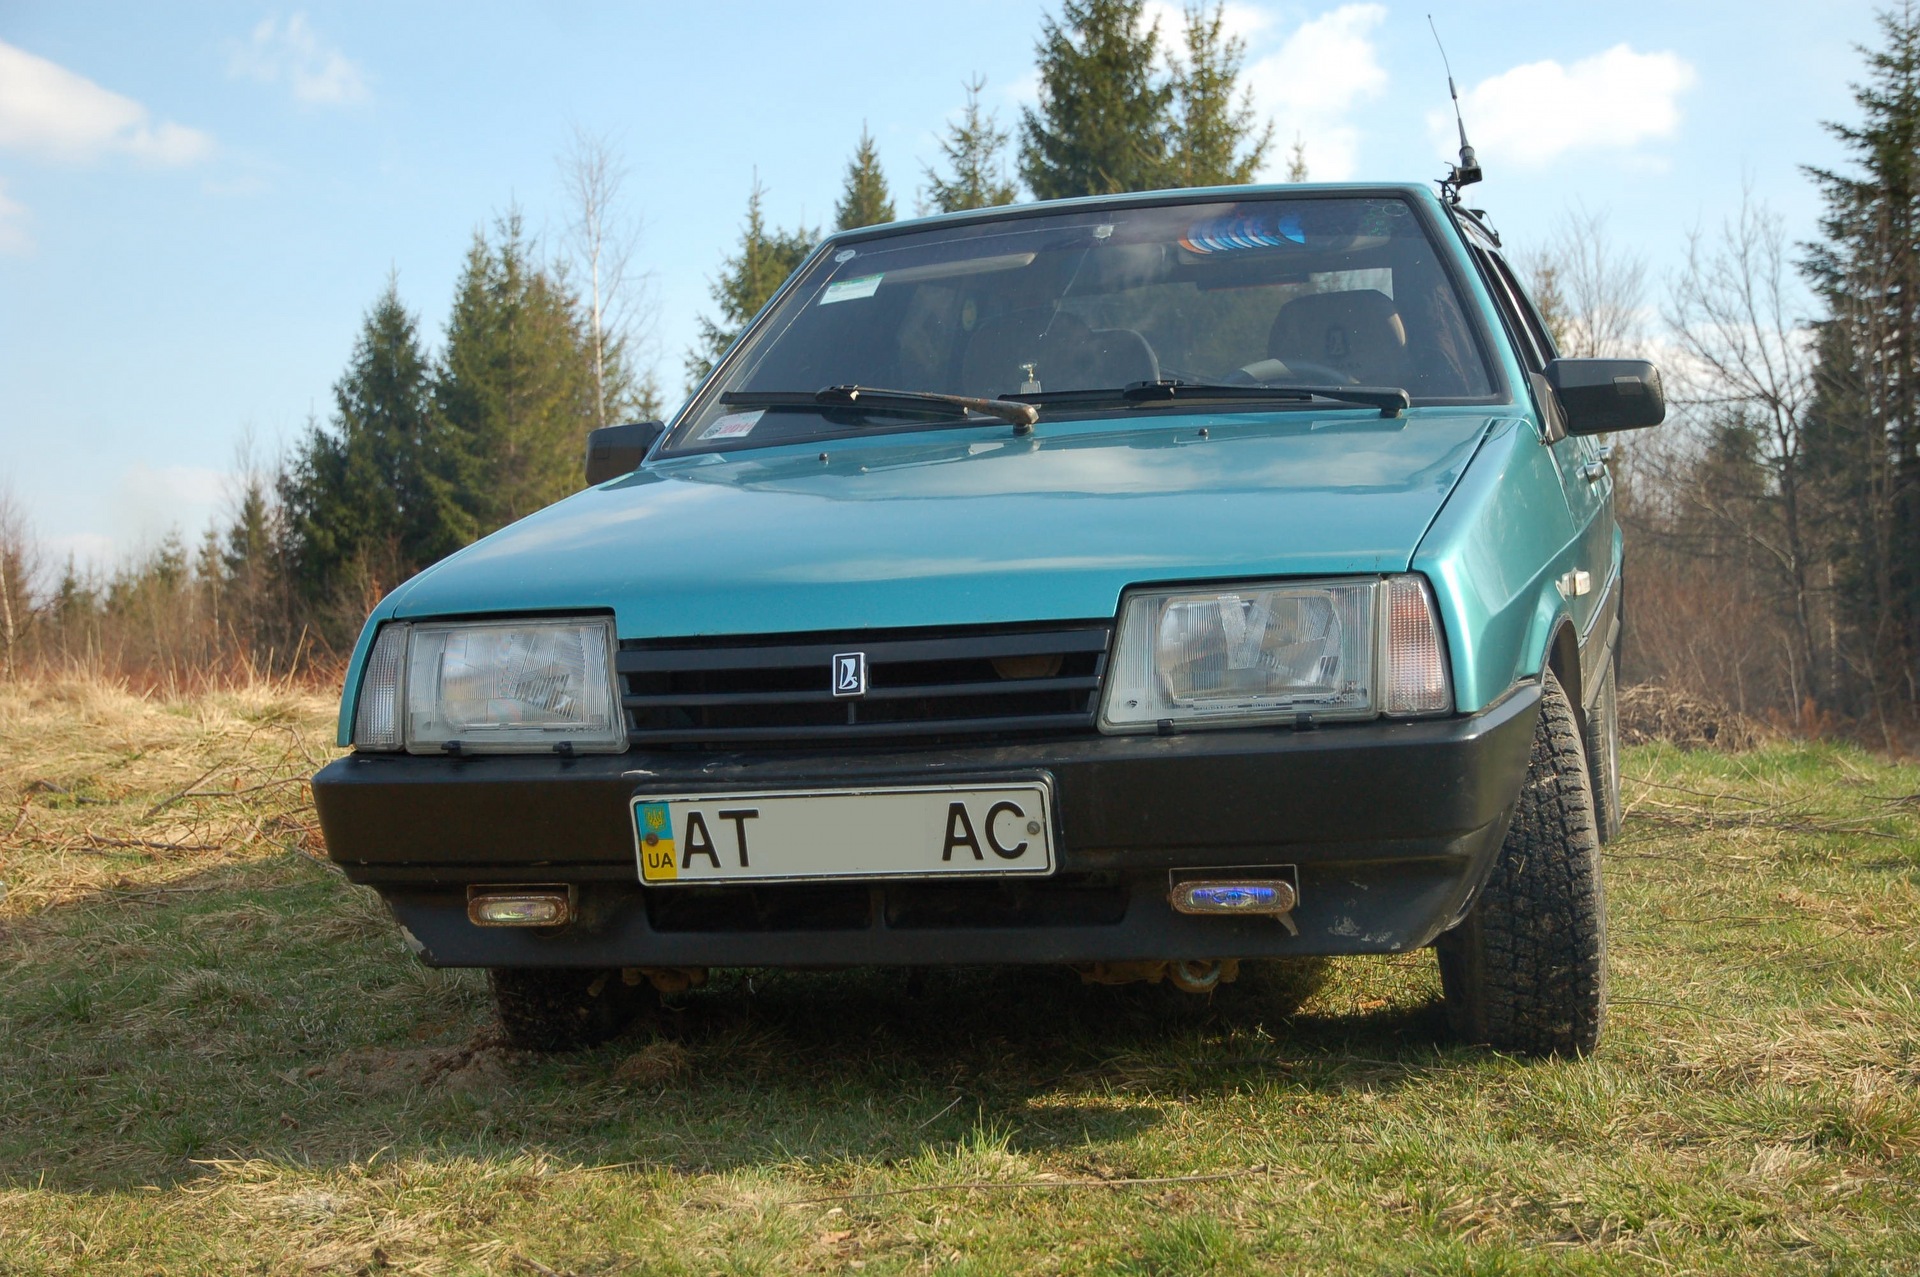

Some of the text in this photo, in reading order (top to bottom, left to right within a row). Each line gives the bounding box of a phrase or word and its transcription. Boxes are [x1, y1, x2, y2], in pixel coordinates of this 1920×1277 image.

[682, 801, 1028, 868] AT AC
[648, 853, 674, 868] UA
